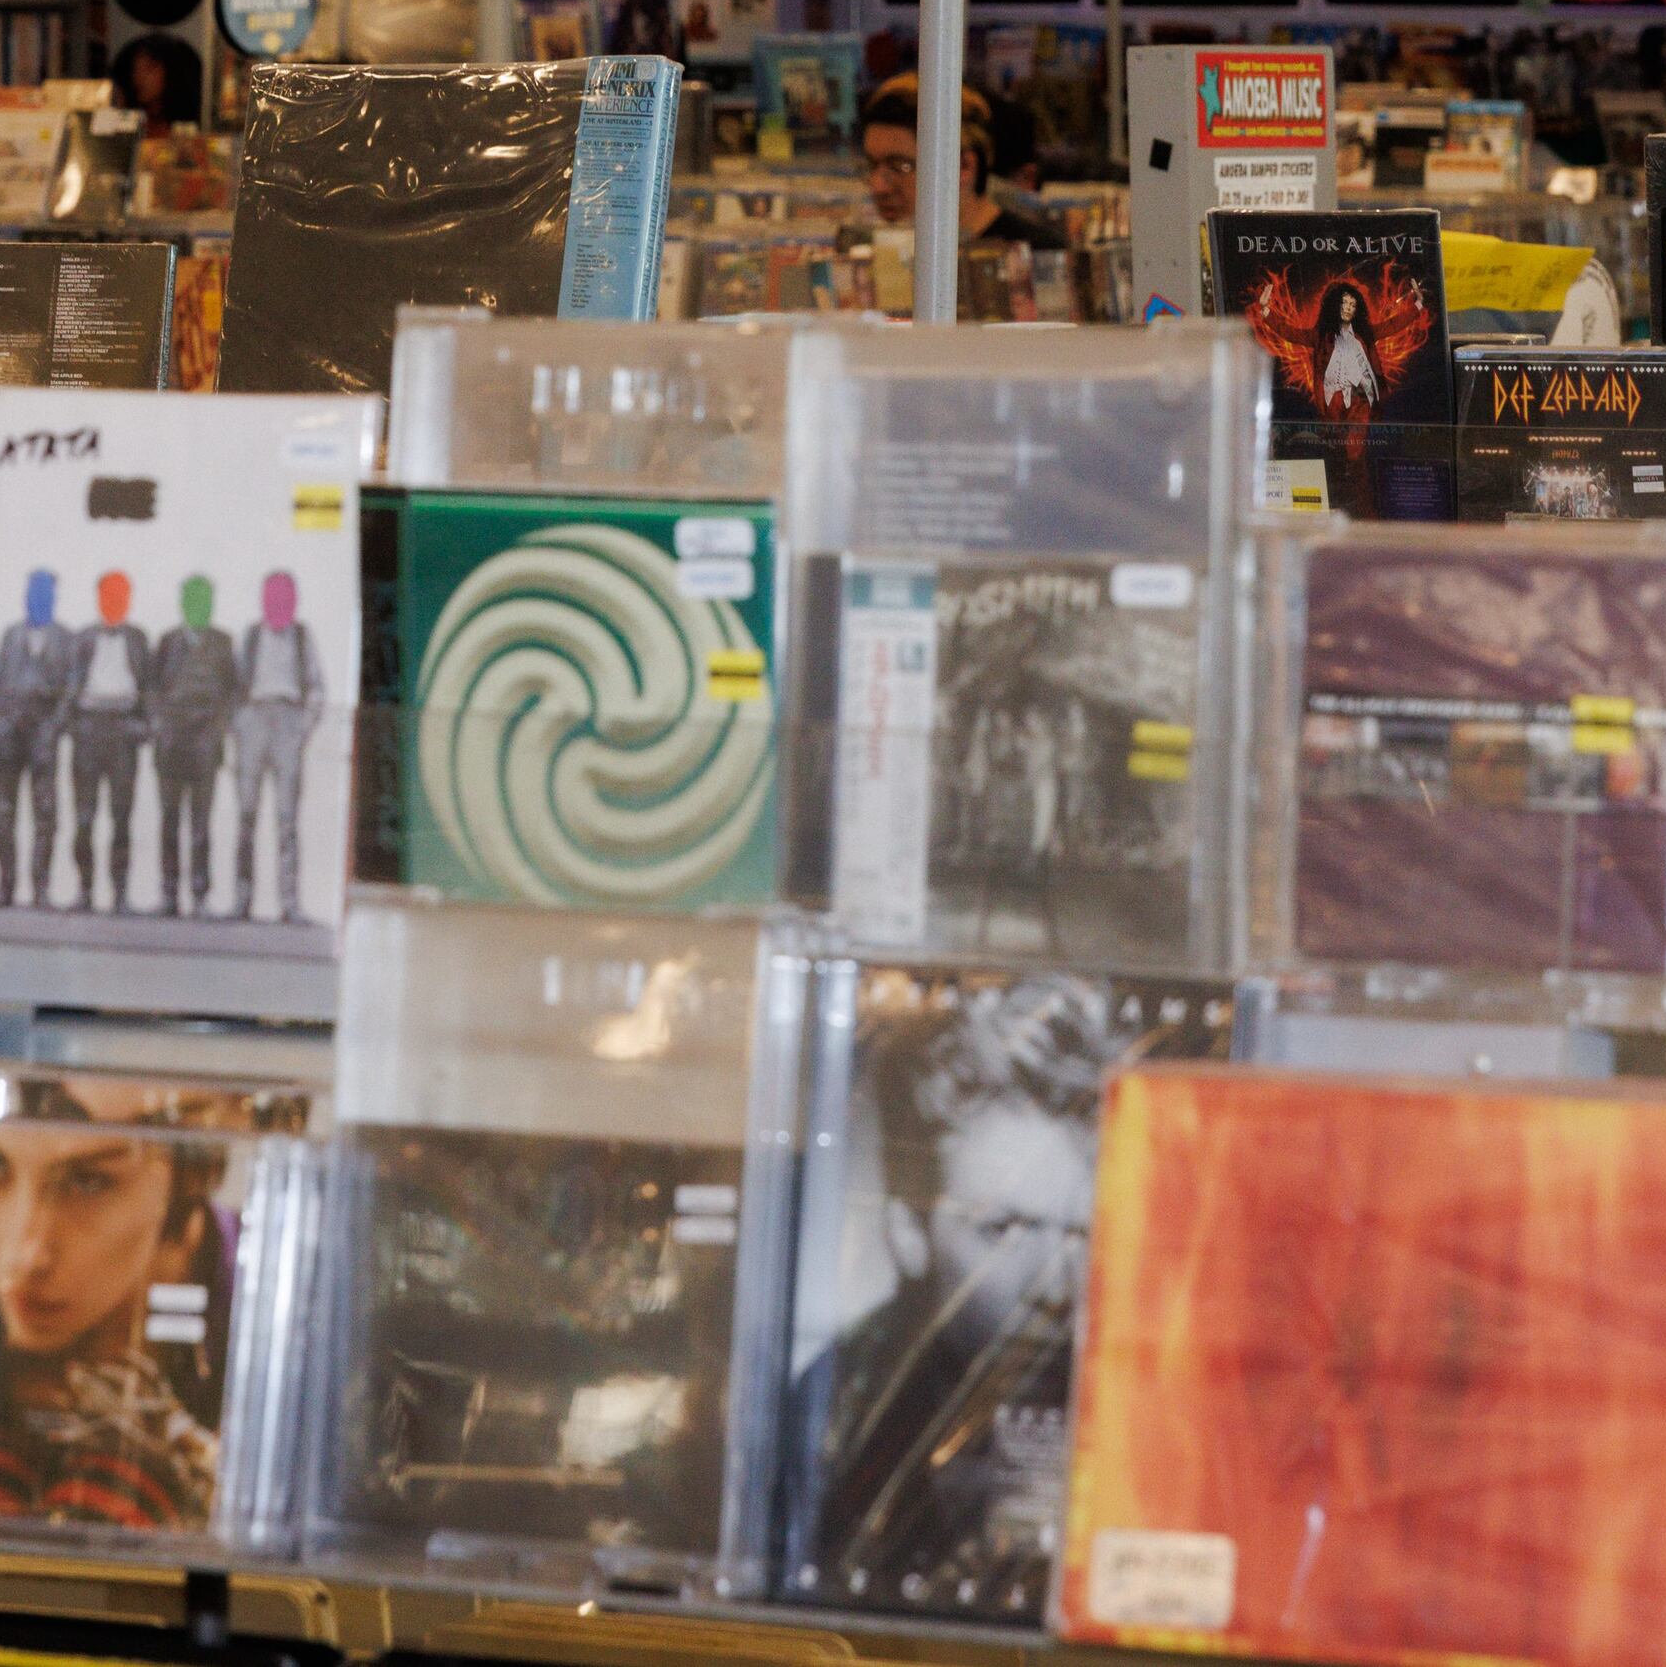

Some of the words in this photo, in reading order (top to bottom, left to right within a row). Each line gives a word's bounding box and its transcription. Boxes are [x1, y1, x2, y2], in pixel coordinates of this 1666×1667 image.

[588, 80, 656, 97] HENDRIX
[1223, 76, 1279, 119] AMOEBA
[1282, 77, 1322, 120] MUSIC
[585, 98, 654, 113] EXPERIENCE
[1220, 163, 1247, 177] AMOEBA
[1251, 163, 1278, 177] BUMPER
[1281, 162, 1313, 176] STICKERS
[1237, 235, 1307, 256] DEAD
[1313, 237, 1339, 253] OR
[1346, 234, 1423, 255] ALIVE
[1492, 368, 1535, 426] DEF
[1539, 368, 1642, 426] LEPPARD
